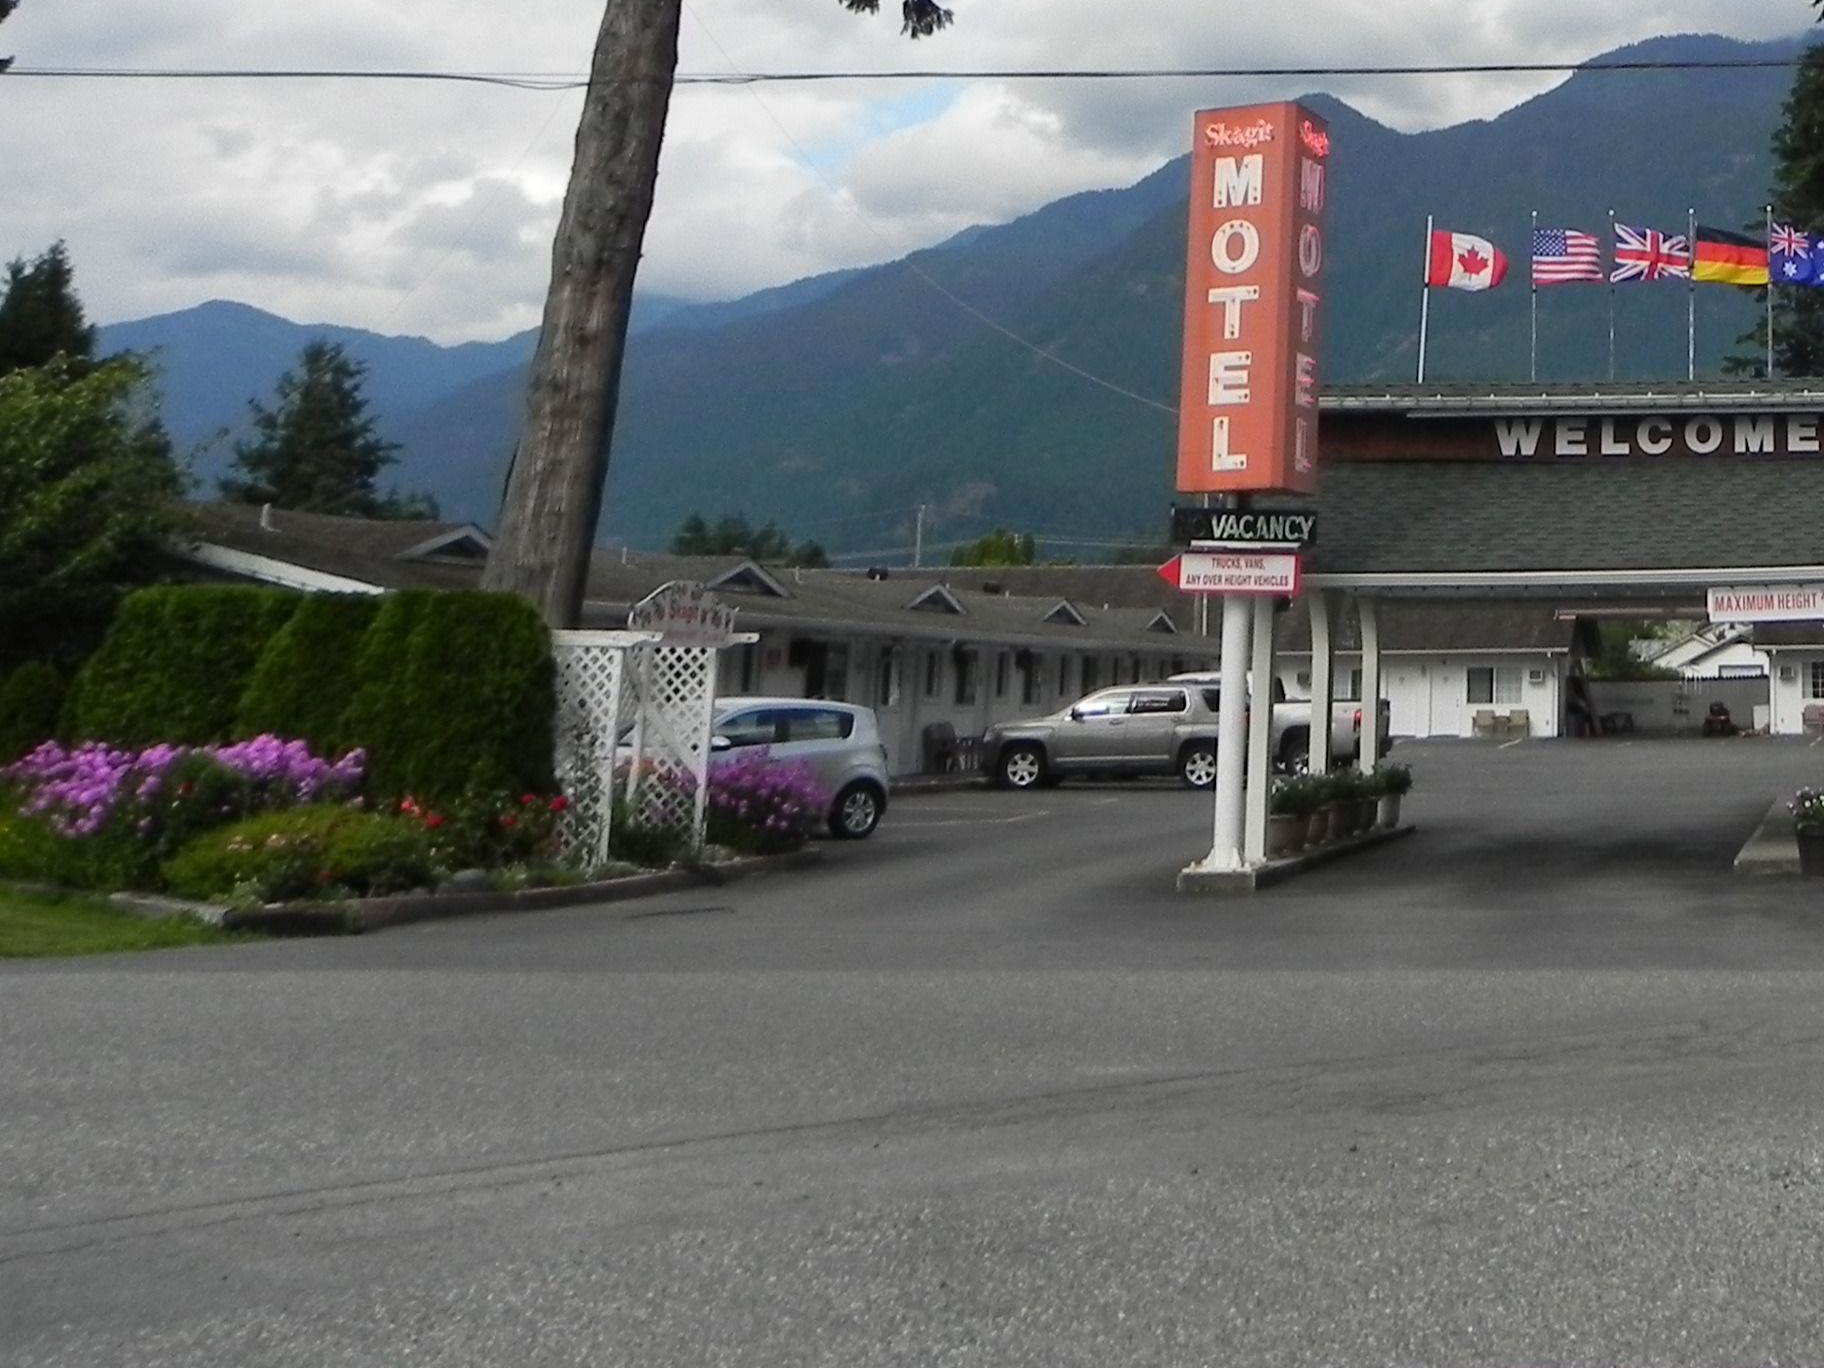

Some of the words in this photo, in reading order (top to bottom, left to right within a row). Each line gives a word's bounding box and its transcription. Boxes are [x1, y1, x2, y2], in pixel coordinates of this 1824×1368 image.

[1204, 119, 1275, 149] Skagit
[1206, 153, 1264, 472] MOTEL
[1495, 416, 1821, 457] WELCOME
[1211, 514, 1315, 541] VACANCY
[1185, 574, 1201, 586] ANY
[1203, 574, 1223, 586] OVER
[1225, 574, 1251, 586] HEIGHT
[1254, 574, 1289, 586] VEHICLES
[1714, 593, 1775, 612] MAXIMUM
[1777, 592, 1817, 610] HEIGHT
